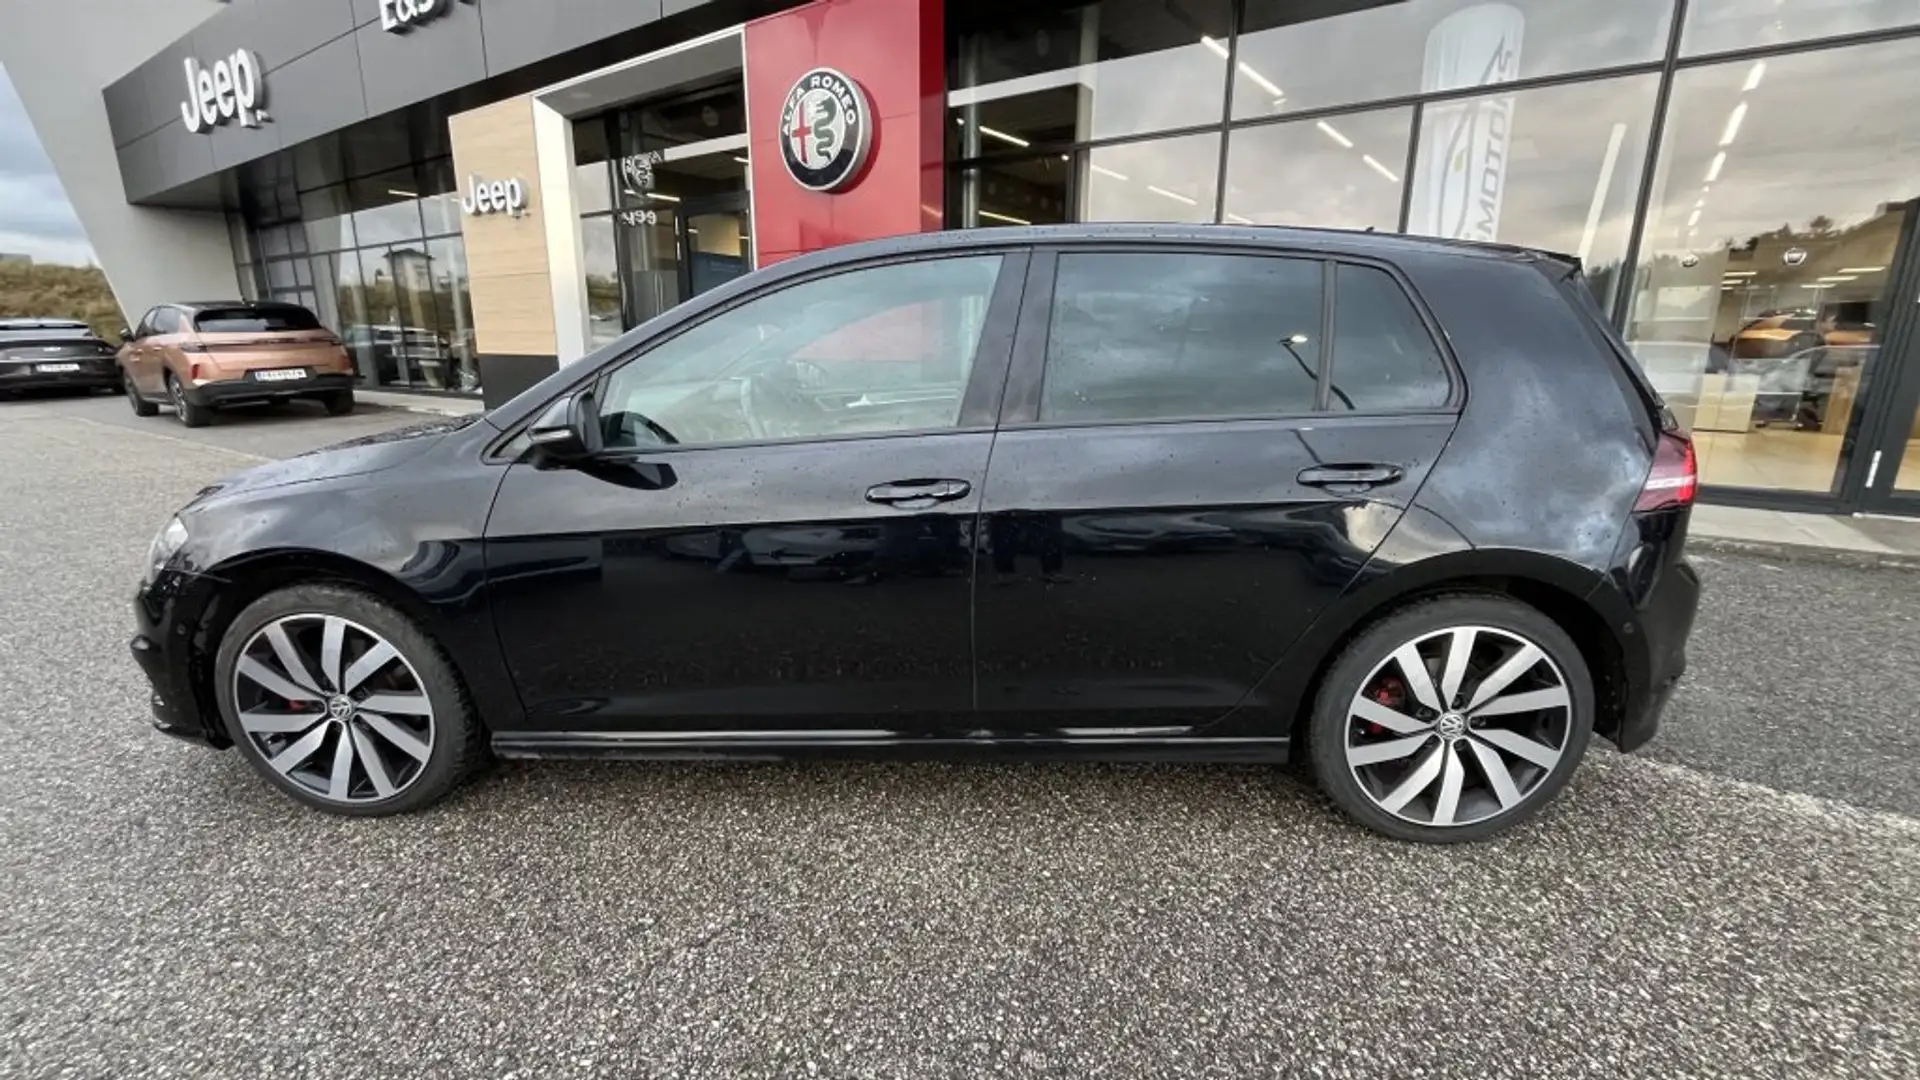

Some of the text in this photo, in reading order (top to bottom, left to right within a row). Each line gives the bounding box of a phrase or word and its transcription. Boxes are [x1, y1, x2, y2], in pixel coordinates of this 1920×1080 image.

[181, 48, 256, 132] Jeep
[782, 75, 856, 136] ALFA ROMEO
[462, 173, 521, 216] Jeep
